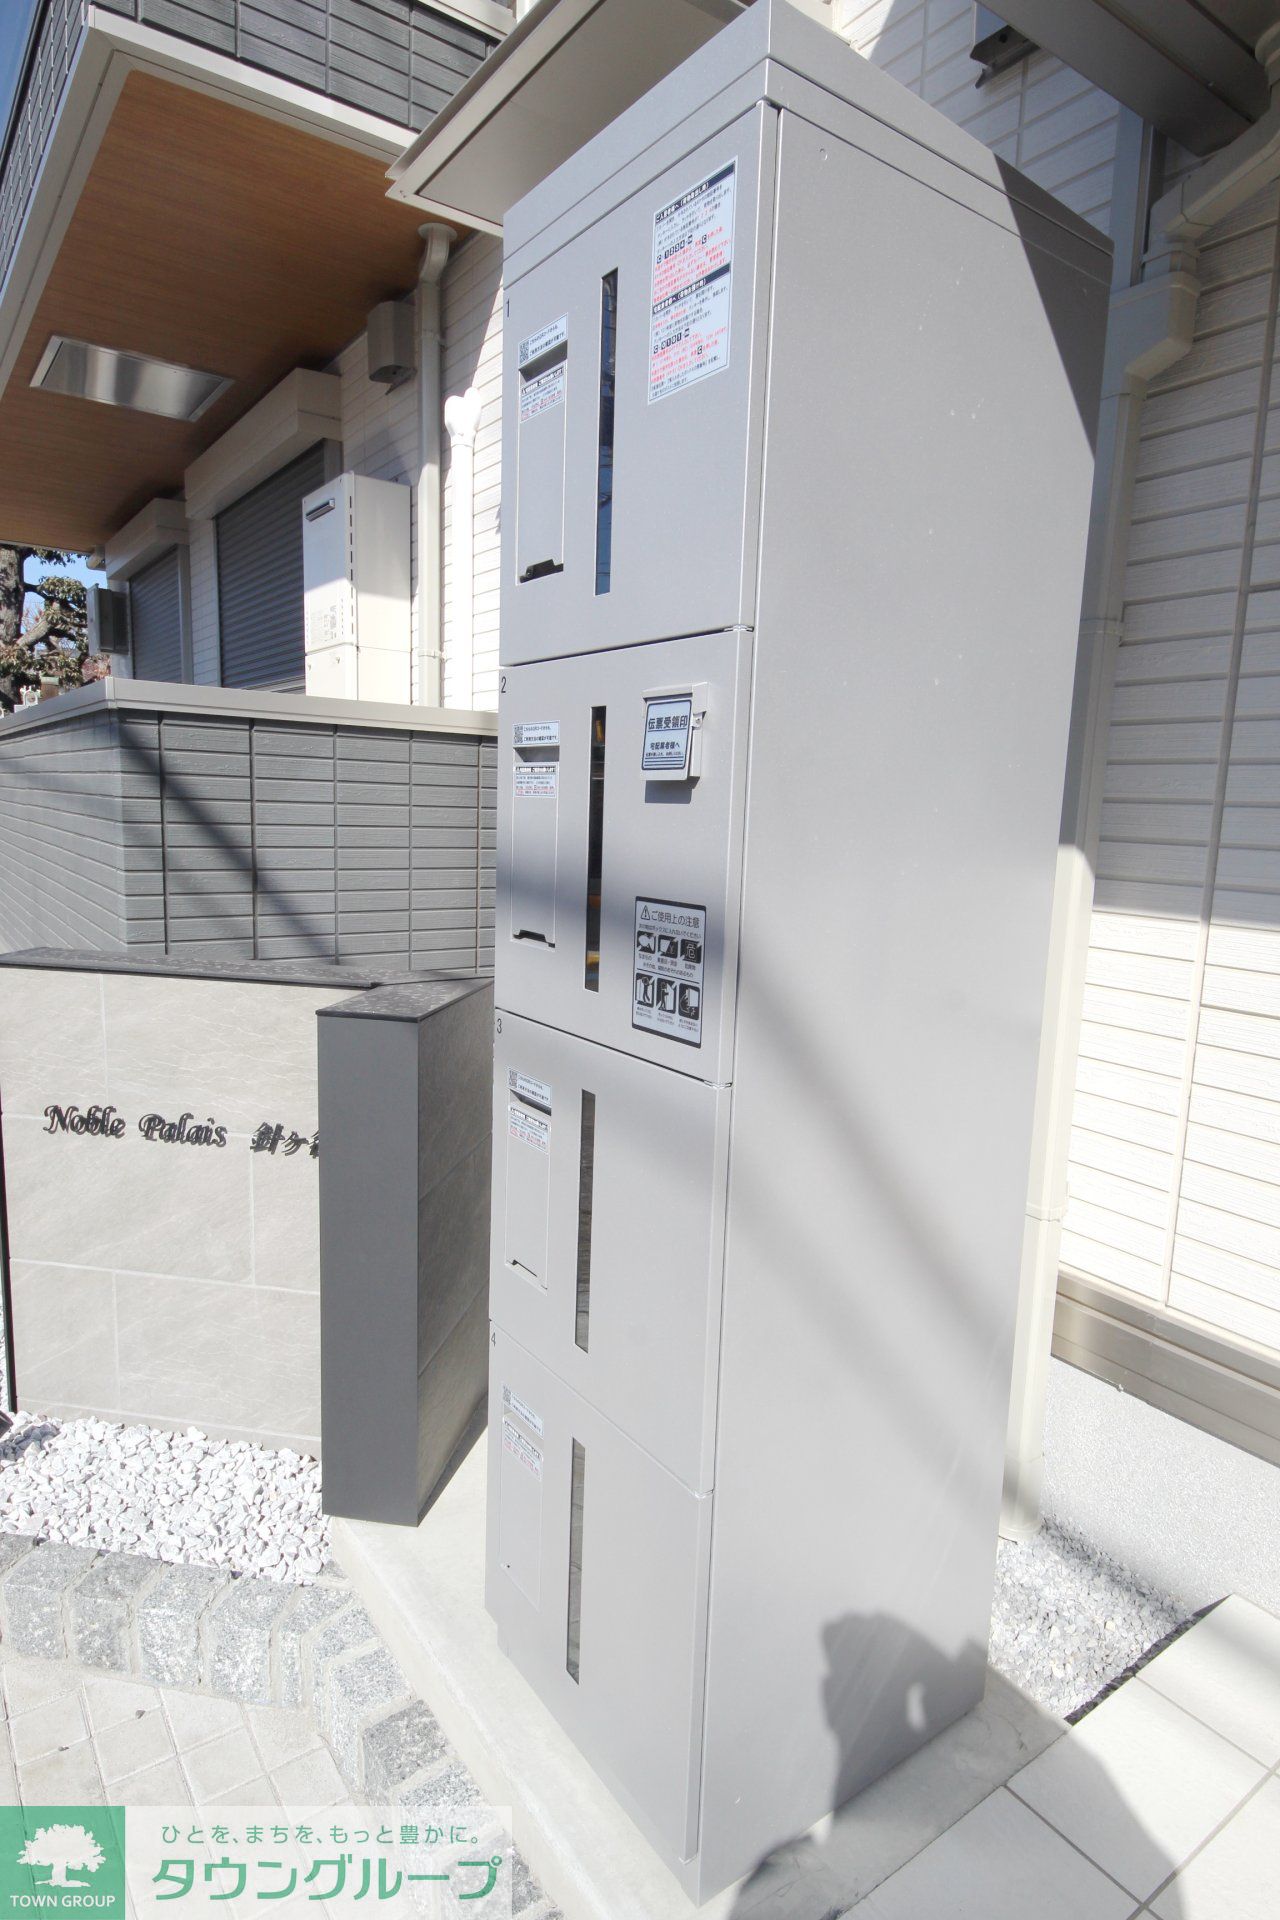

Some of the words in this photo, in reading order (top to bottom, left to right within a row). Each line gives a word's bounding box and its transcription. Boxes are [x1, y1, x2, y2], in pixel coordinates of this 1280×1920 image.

[500, 676, 507, 693] 2
[648, 714, 689, 730] 伝票受領印
[651, 910, 700, 929] ご使用上の注意
[496, 1018, 502, 1034] 3
[43, 1105, 126, 1139] Noble
[138, 1112, 228, 1148] Palais
[491, 1332, 496, 1347] 4
